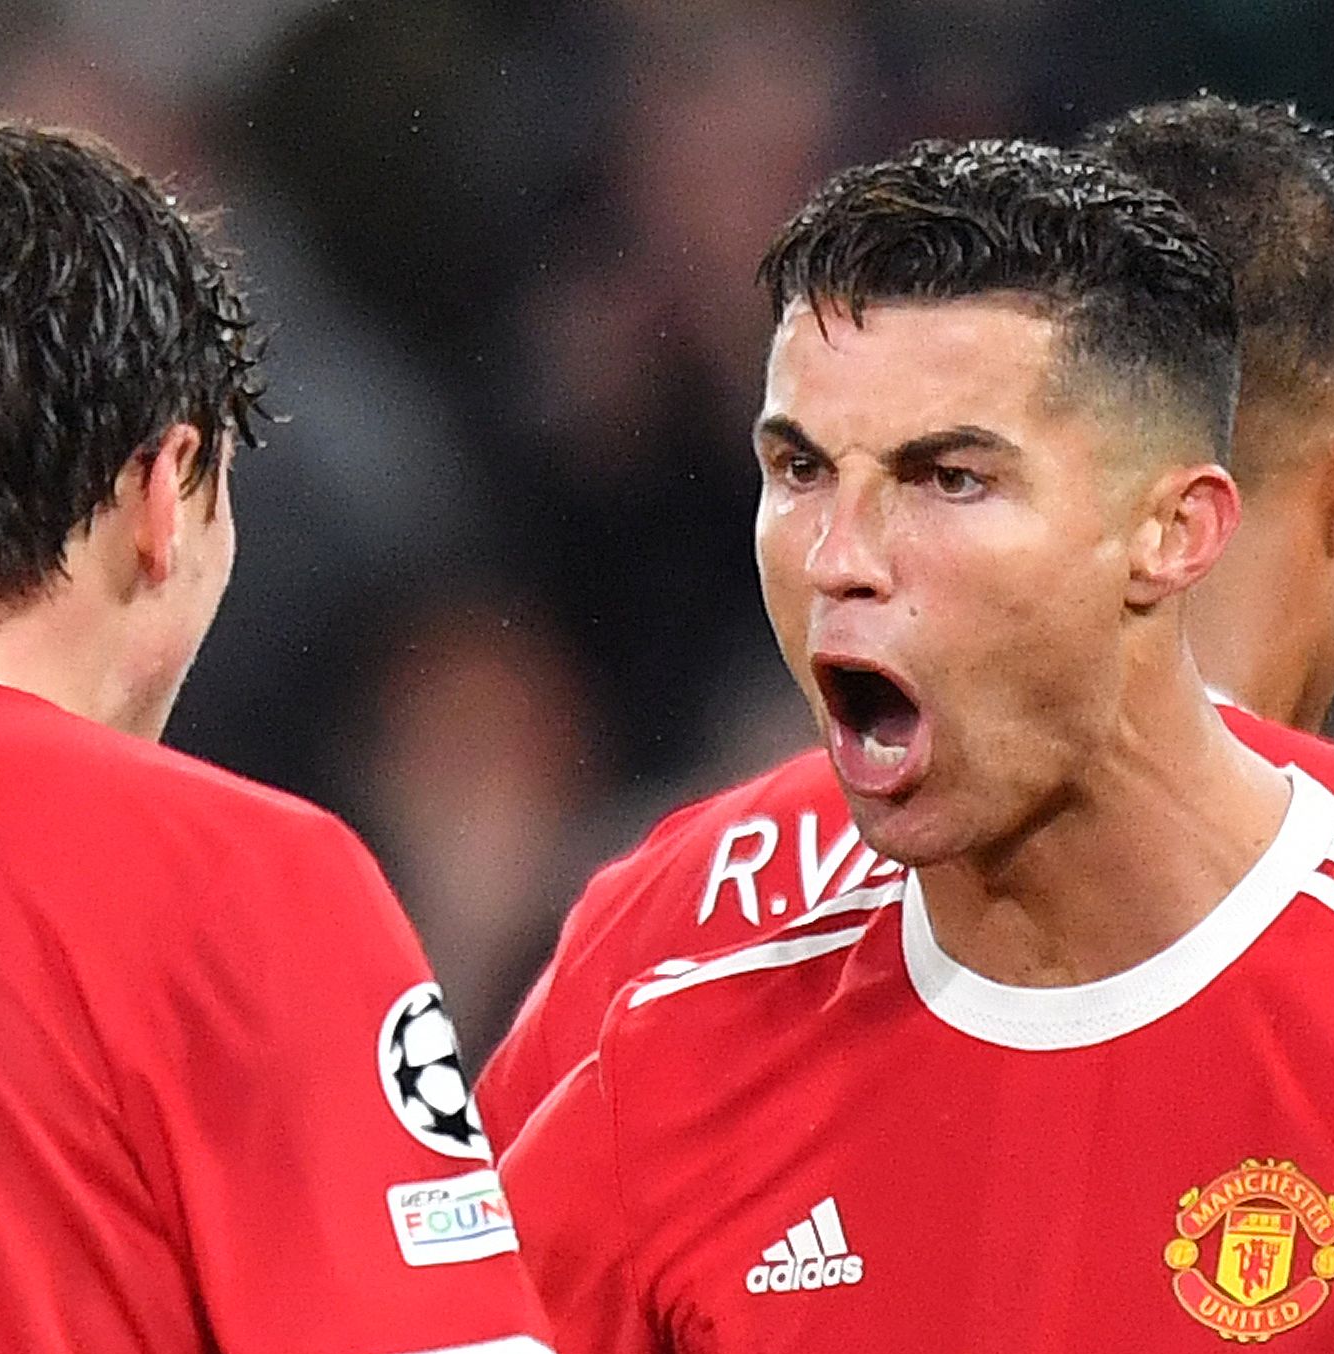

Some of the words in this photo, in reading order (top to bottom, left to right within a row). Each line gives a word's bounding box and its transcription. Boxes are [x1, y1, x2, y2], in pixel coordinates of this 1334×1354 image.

[1190, 1174, 1332, 1233] MANCHESTER
[746, 1255, 864, 1294] adidas
[1198, 1296, 1300, 1329] UNITED
